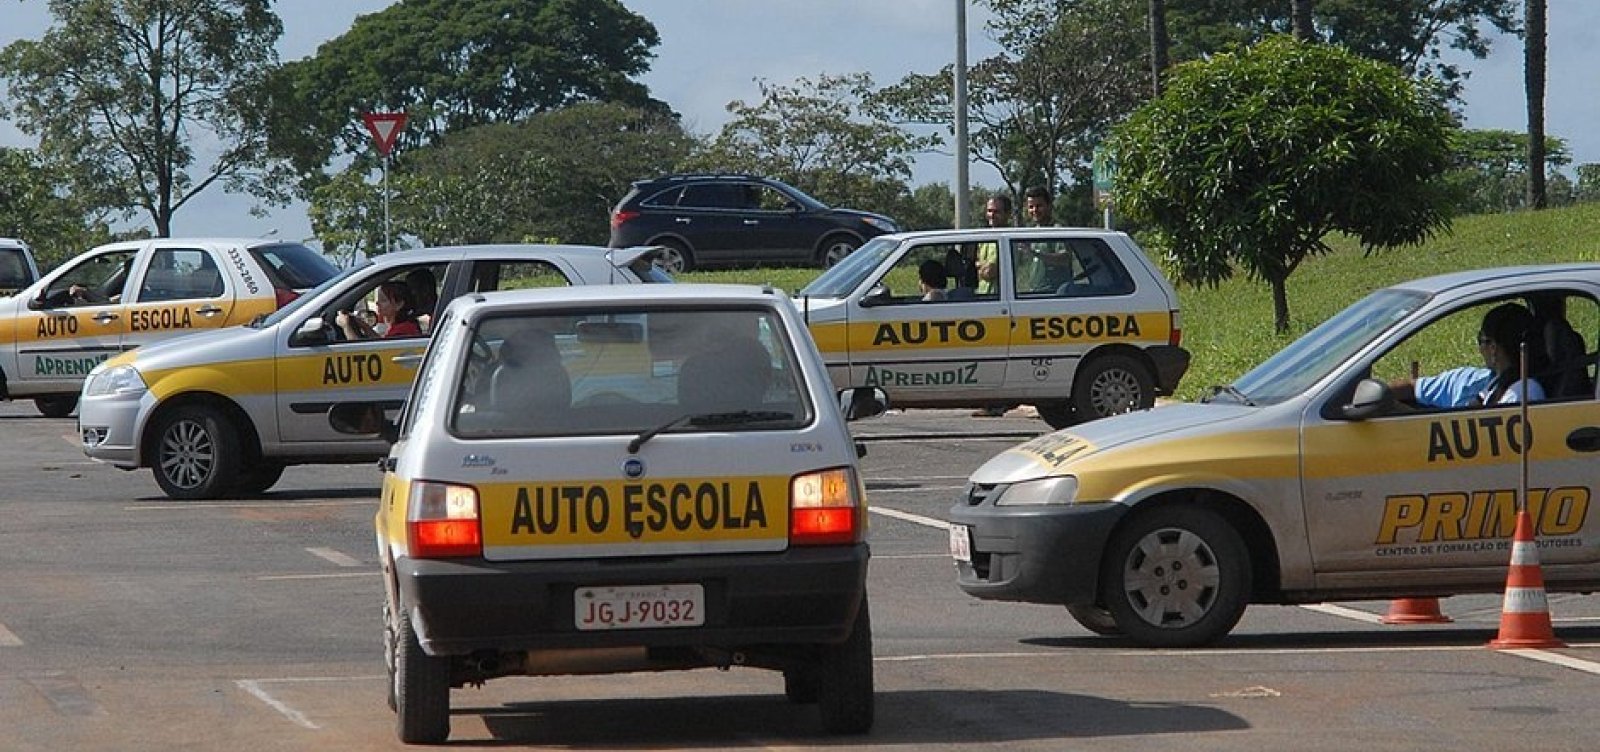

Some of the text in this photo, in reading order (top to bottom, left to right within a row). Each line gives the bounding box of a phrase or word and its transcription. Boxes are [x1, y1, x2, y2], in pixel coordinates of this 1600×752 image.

[37, 307, 193, 339] AUTO ESCOLA
[873, 315, 1141, 346] AUTO ESCOLA
[35, 353, 108, 376] APREND
[323, 353, 382, 385] AUTO
[865, 361, 978, 387] APRENDIZ
[1428, 414, 1533, 462] AUTO
[511, 481, 768, 535] AUTO ESCOLA
[1375, 485, 1591, 544] PRIMO
[1376, 546, 1417, 557] CENTRO
[1420, 544, 1434, 555] DE
[1496, 540, 1510, 550] DE
[583, 600, 695, 624] JGJ-9032
